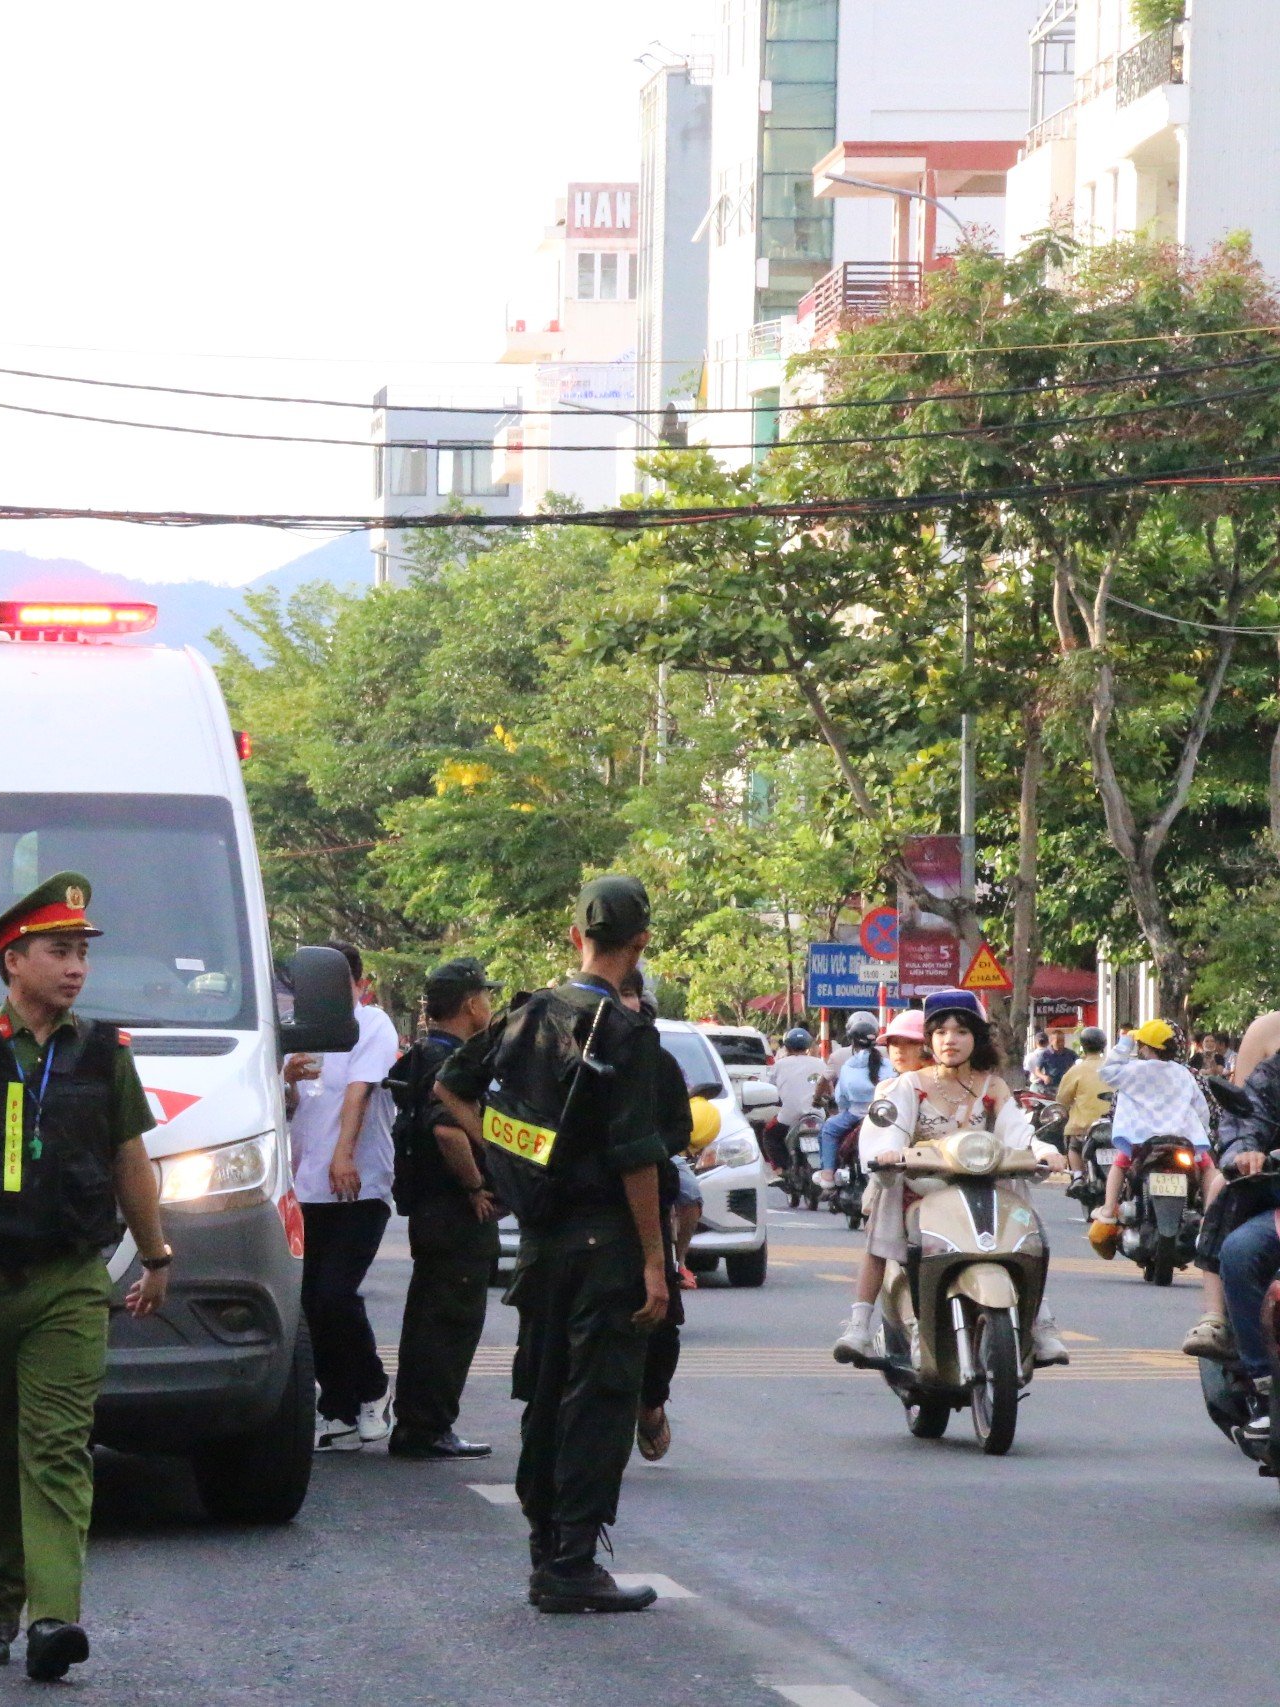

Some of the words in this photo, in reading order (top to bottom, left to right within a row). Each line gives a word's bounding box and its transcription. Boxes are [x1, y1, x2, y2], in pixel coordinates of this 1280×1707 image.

[574, 191, 631, 229] HAN
[812, 954, 828, 975] KHU
[817, 984, 833, 996] SEA
[835, 984, 876, 997] BOUNDARY
[9, 1100, 18, 1175] POLICE
